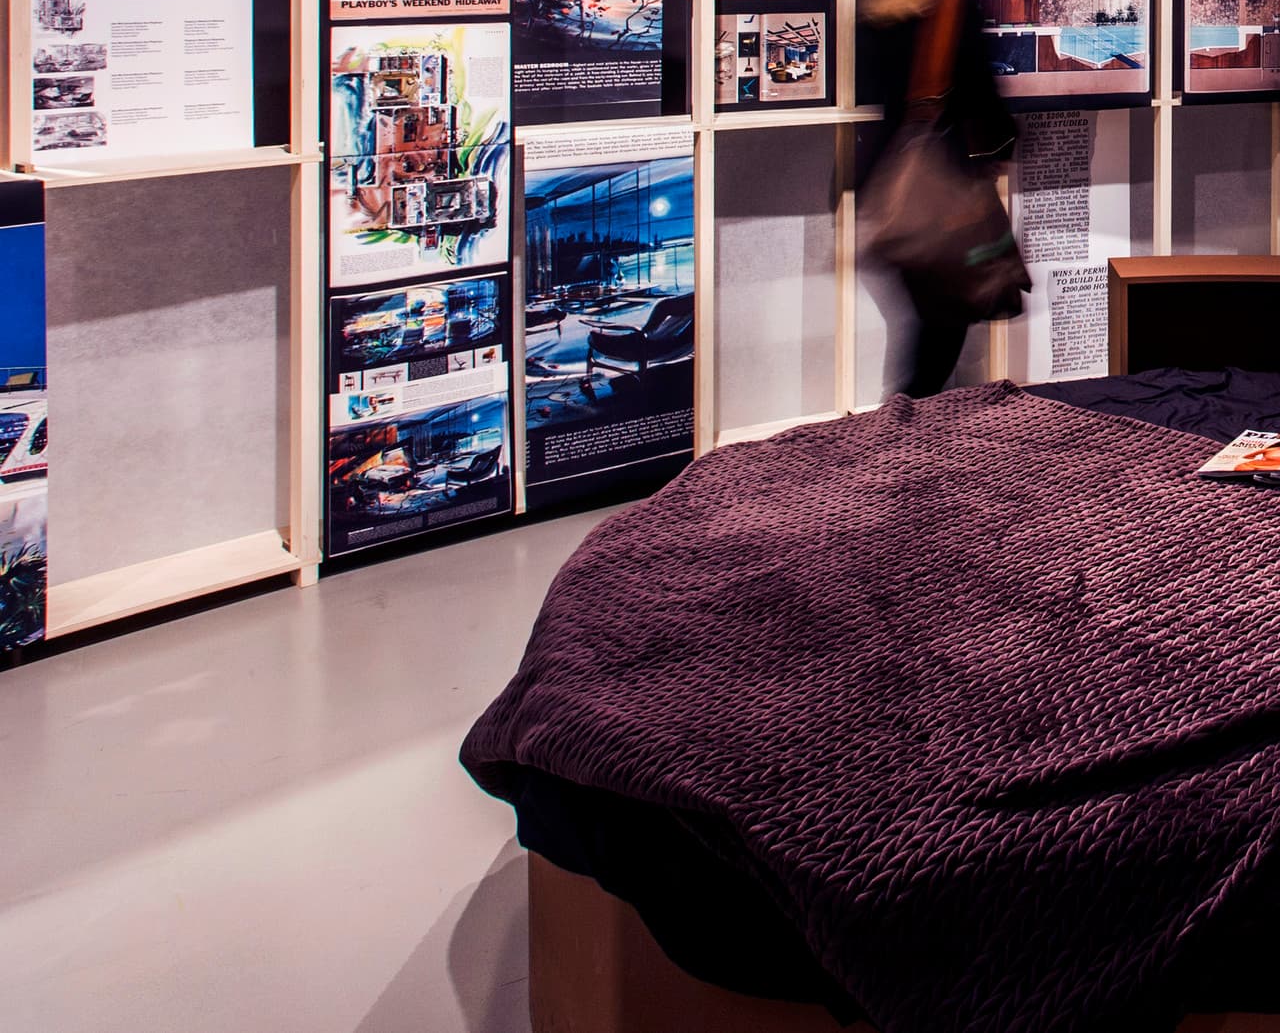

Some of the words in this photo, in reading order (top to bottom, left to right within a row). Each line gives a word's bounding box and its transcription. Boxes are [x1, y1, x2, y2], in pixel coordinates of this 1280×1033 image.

[341, 0, 397, 8] PLAYBOY'S
[402, 0, 451, 7] WEEKEND
[1053, 118, 1088, 127] STUDIED
[1052, 270, 1073, 278] WINS
[1083, 266, 1107, 275] PERMI
[1056, 278, 1068, 286] TO
[1069, 275, 1093, 285] BUILD
[1062, 283, 1092, 294] $200,000
